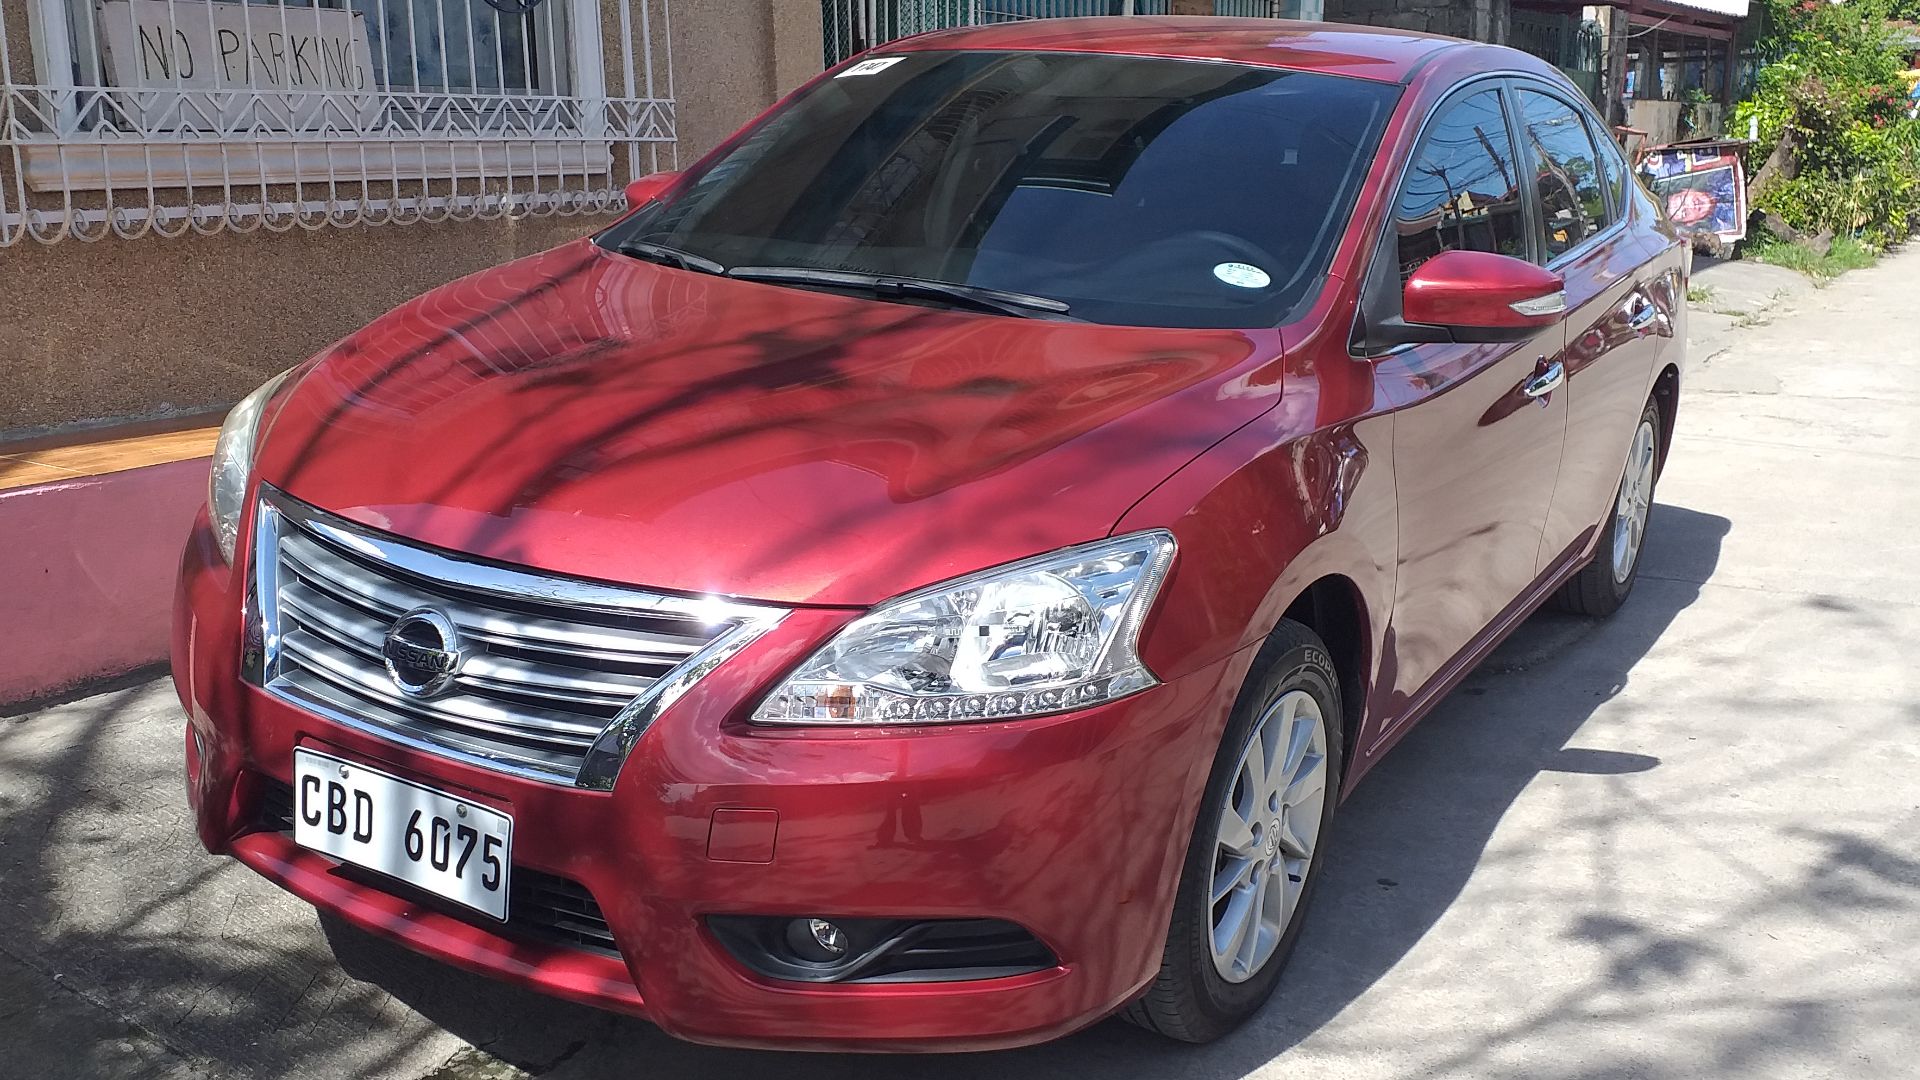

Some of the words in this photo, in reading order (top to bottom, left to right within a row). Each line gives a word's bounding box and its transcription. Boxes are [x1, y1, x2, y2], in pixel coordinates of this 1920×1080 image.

[139, 25, 194, 80] NO
[384, 638, 446, 669] NSSAN
[301, 774, 373, 844] CBD
[404, 809, 503, 892] 6075
